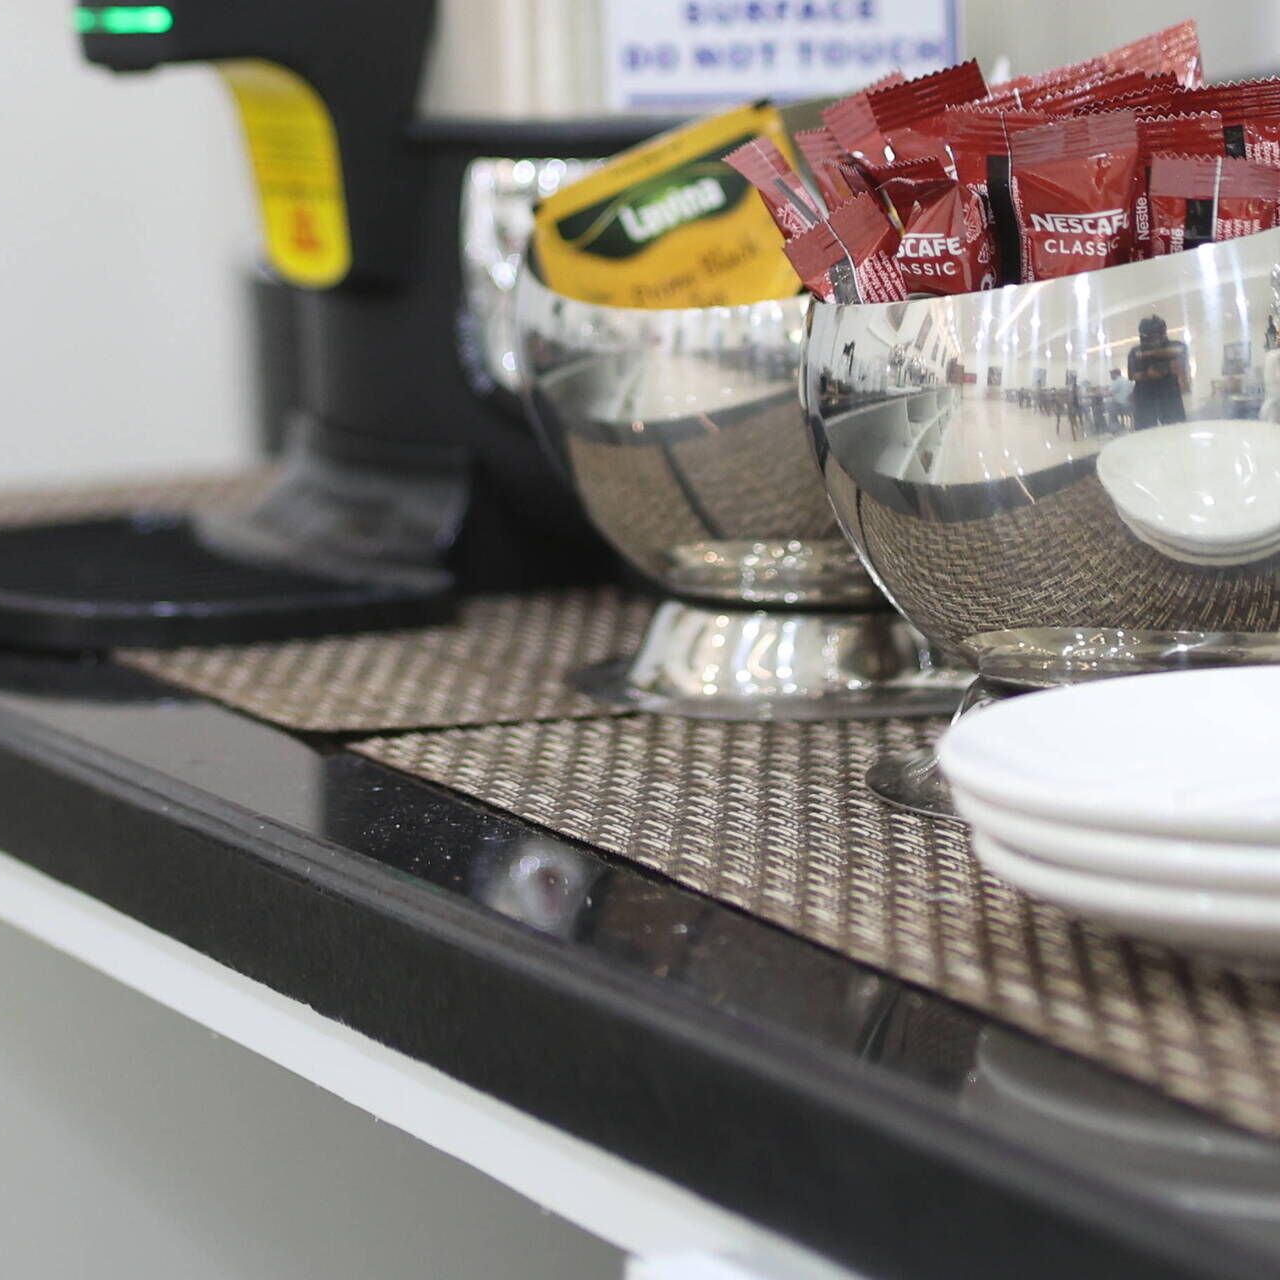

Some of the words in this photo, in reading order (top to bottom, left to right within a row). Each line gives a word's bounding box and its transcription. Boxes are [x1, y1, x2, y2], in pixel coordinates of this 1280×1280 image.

[626, 44, 681, 72] DO
[693, 40, 777, 70] NOT
[796, 36, 945, 66] TOUCH
[1044, 237, 1120, 256] CLASSIC
